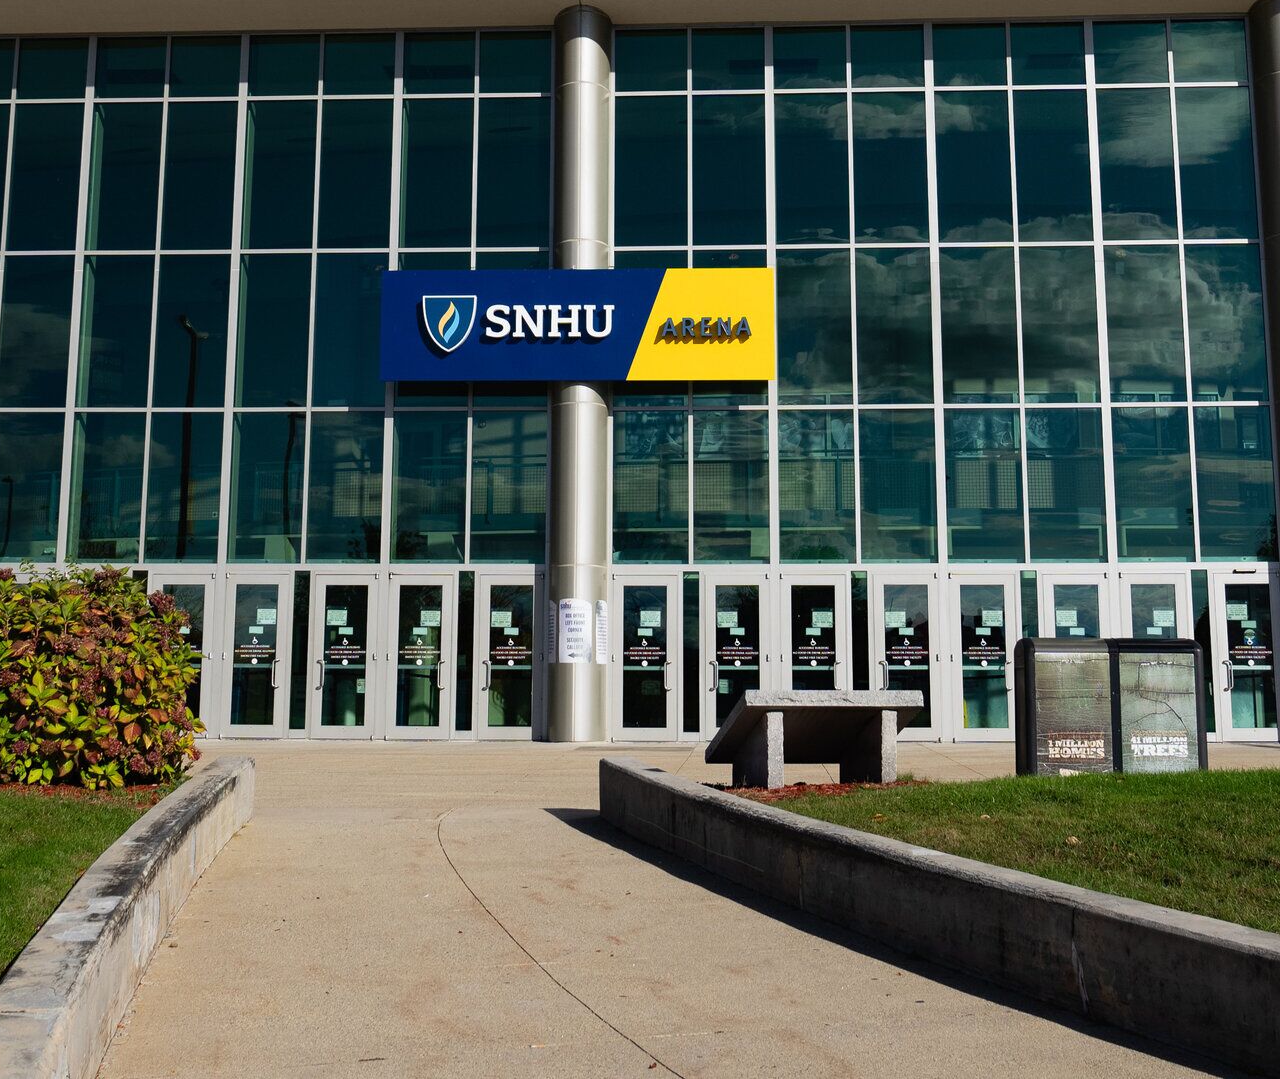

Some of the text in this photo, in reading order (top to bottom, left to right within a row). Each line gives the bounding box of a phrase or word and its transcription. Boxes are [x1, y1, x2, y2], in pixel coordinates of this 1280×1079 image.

[485, 304, 751, 338] SNHU ARENA
[1048, 748, 1105, 758] HOMES
[1131, 744, 1188, 757] TREES
